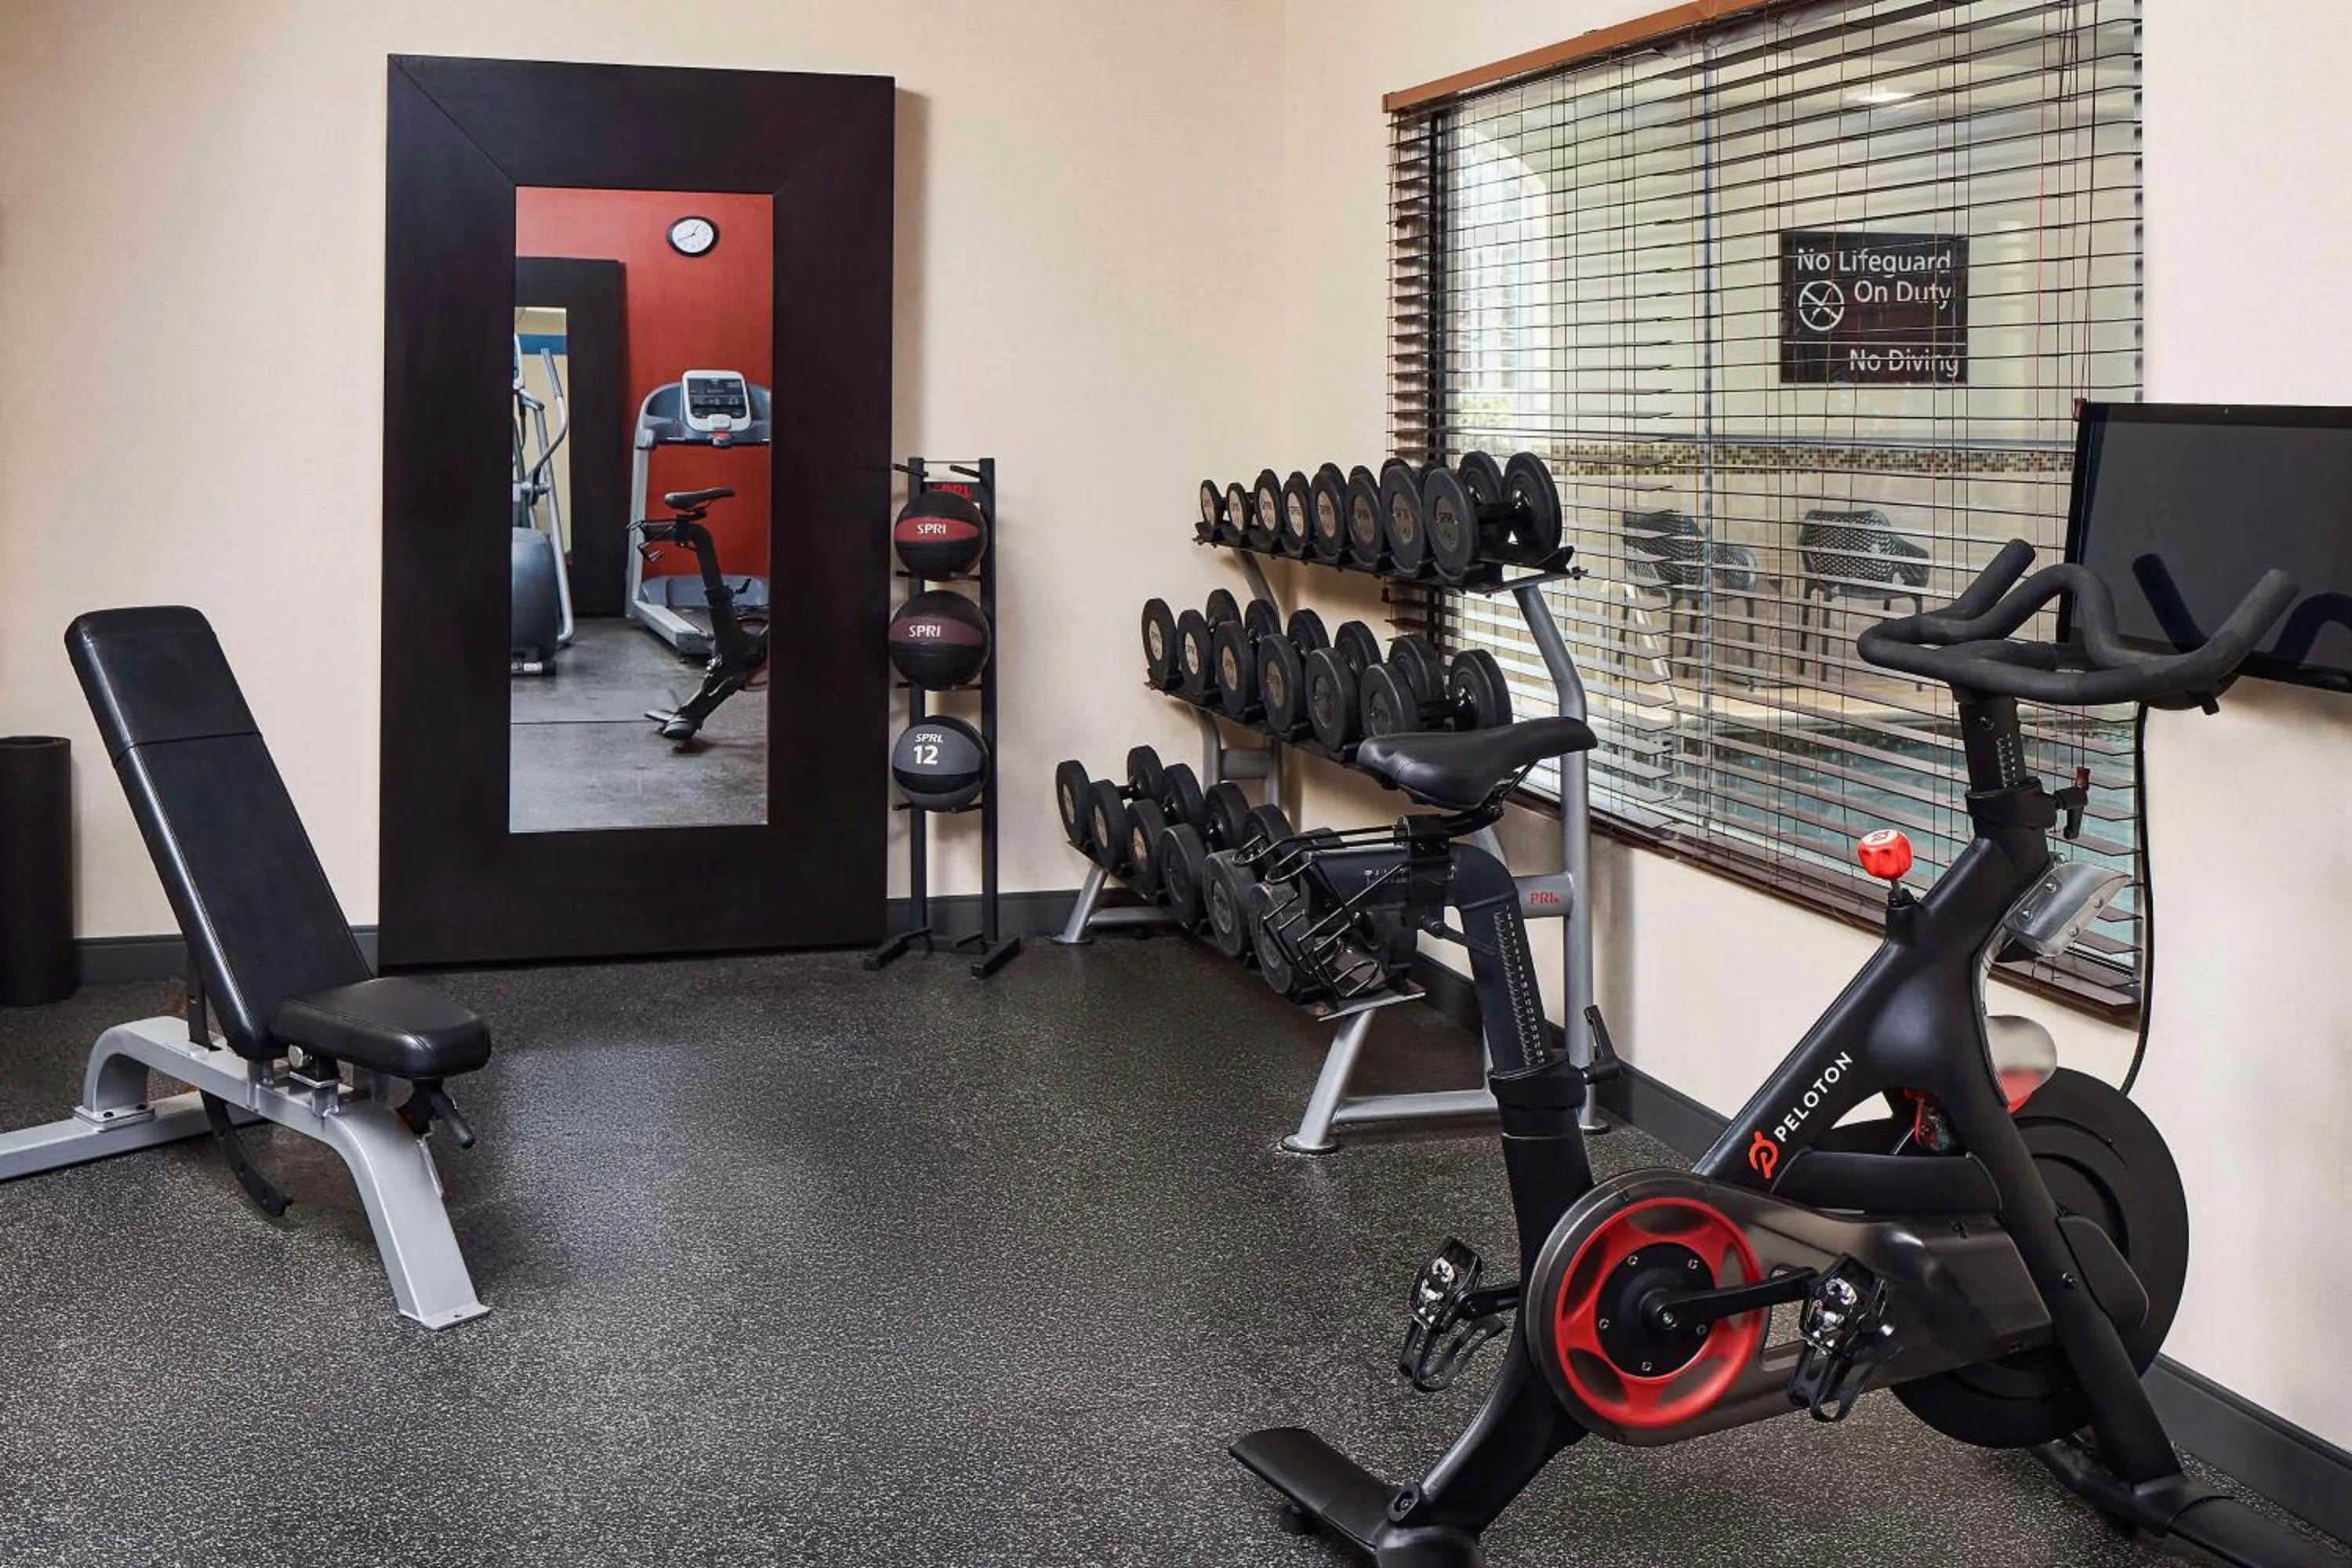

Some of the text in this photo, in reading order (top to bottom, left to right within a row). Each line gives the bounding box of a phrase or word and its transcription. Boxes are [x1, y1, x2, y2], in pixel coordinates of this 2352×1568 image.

[1798, 248, 1951, 278] No Lifeguard
[1854, 280, 1951, 309] On Duty
[1849, 348, 1959, 377] No Diving
[916, 523, 946, 535] SPRI
[909, 624, 941, 637] SPRI
[913, 744, 938, 765] 12
[1773, 1051, 1853, 1142] PELOTON
